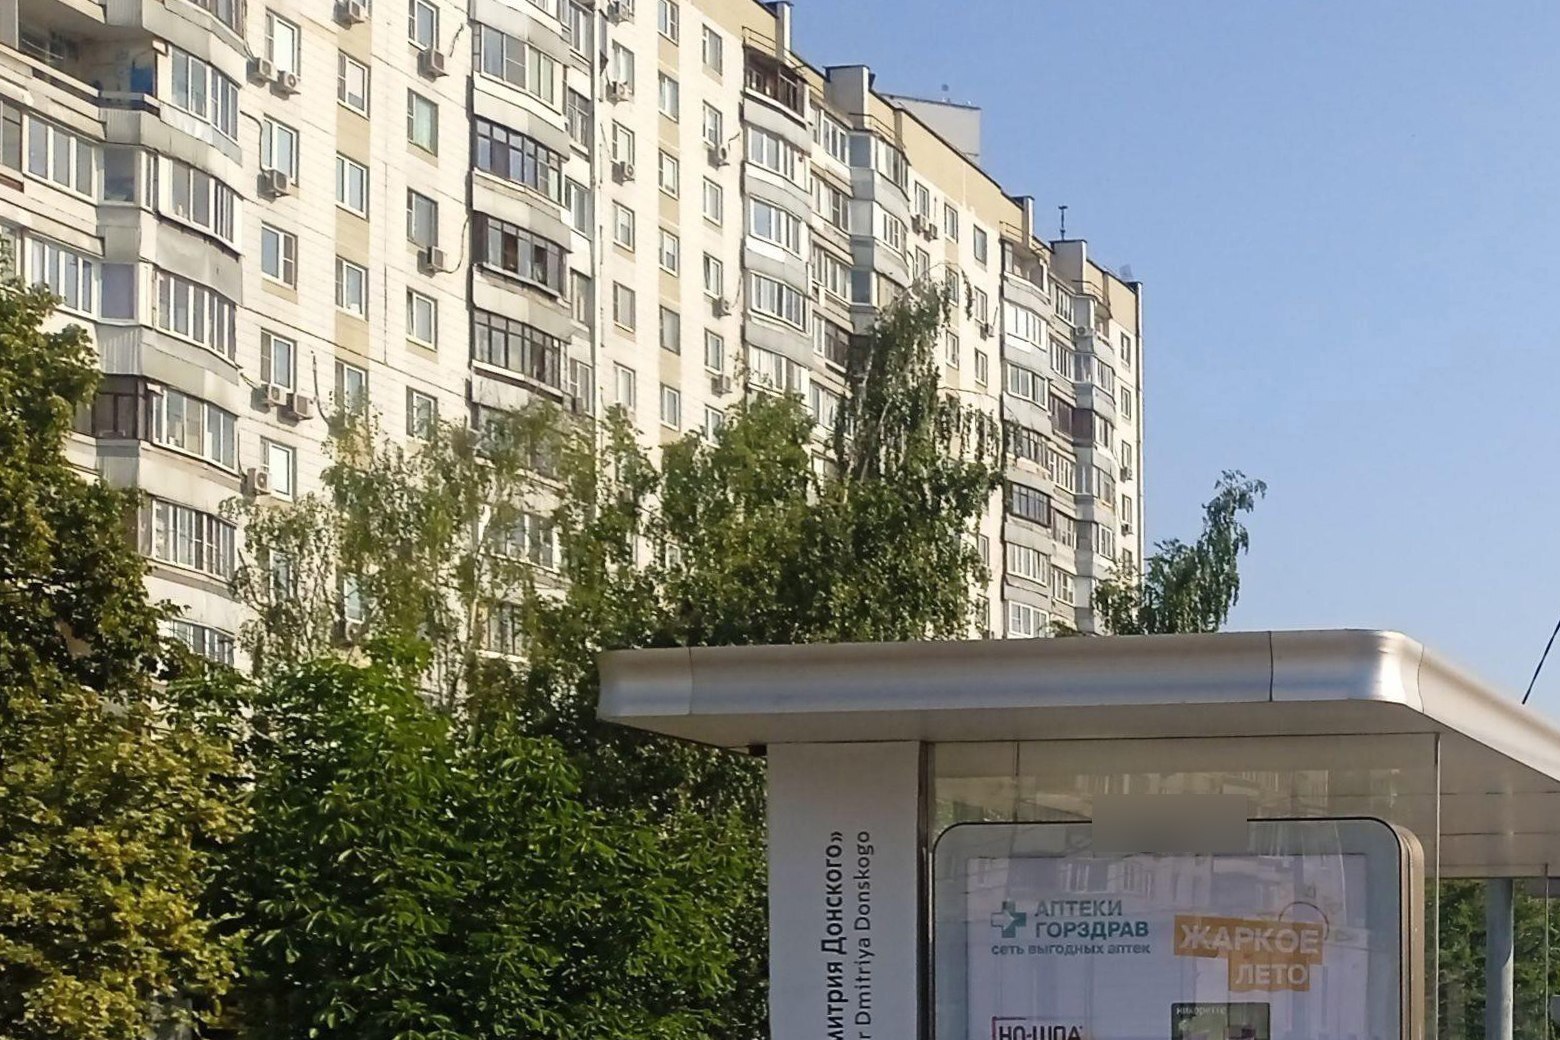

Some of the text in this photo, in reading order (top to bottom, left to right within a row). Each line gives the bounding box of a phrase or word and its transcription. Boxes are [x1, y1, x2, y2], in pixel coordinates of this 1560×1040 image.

[821, 831, 844, 955] Донского»
[855, 831, 874, 931] Donskogo
[1034, 900, 1122, 917] АПТЕКИ
[1035, 921, 1150, 940] ГОРЗДРАВ
[1180, 924, 1320, 954] ЖАРКОЕ
[991, 943, 1151, 956] сеть выгодных аптек
[855, 938, 874, 1026] Dmitriya
[1234, 963, 1308, 985] ЛЕТО
